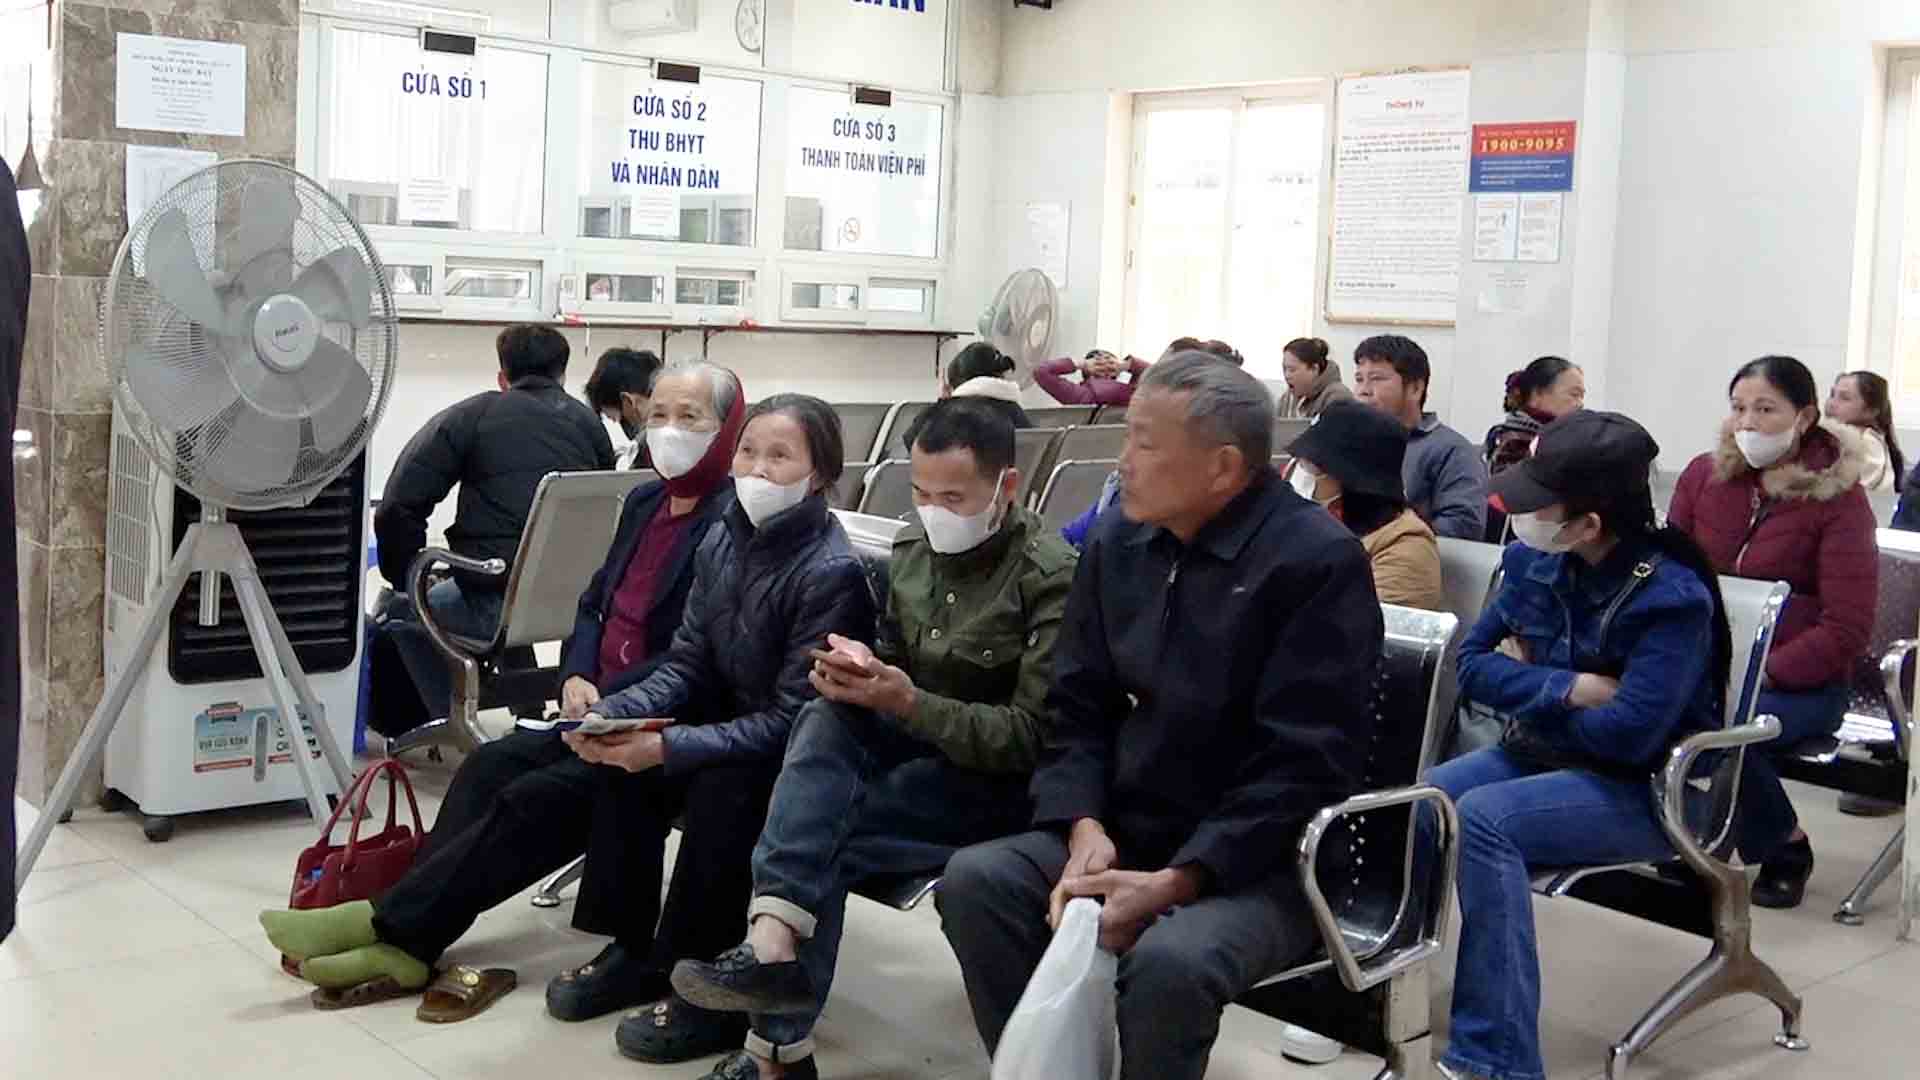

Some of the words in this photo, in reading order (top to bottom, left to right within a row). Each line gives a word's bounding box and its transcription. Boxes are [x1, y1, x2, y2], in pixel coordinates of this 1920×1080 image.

[480, 79, 486, 100] 1
[697, 101, 706, 121] 2
[629, 128, 660, 151] THU
[665, 131, 705, 154] BHYT
[887, 123, 897, 142] 3
[1480, 136, 1566, 153] 1900-9095
[611, 157, 630, 183] VÀ
[636, 161, 682, 187] NHÂN
[687, 164, 720, 189] DÂN
[801, 146, 840, 169] THANH
[845, 148, 875, 172] TOÁN
[877, 150, 904, 180] VIỆN
[906, 153, 926, 177] PHÍ
